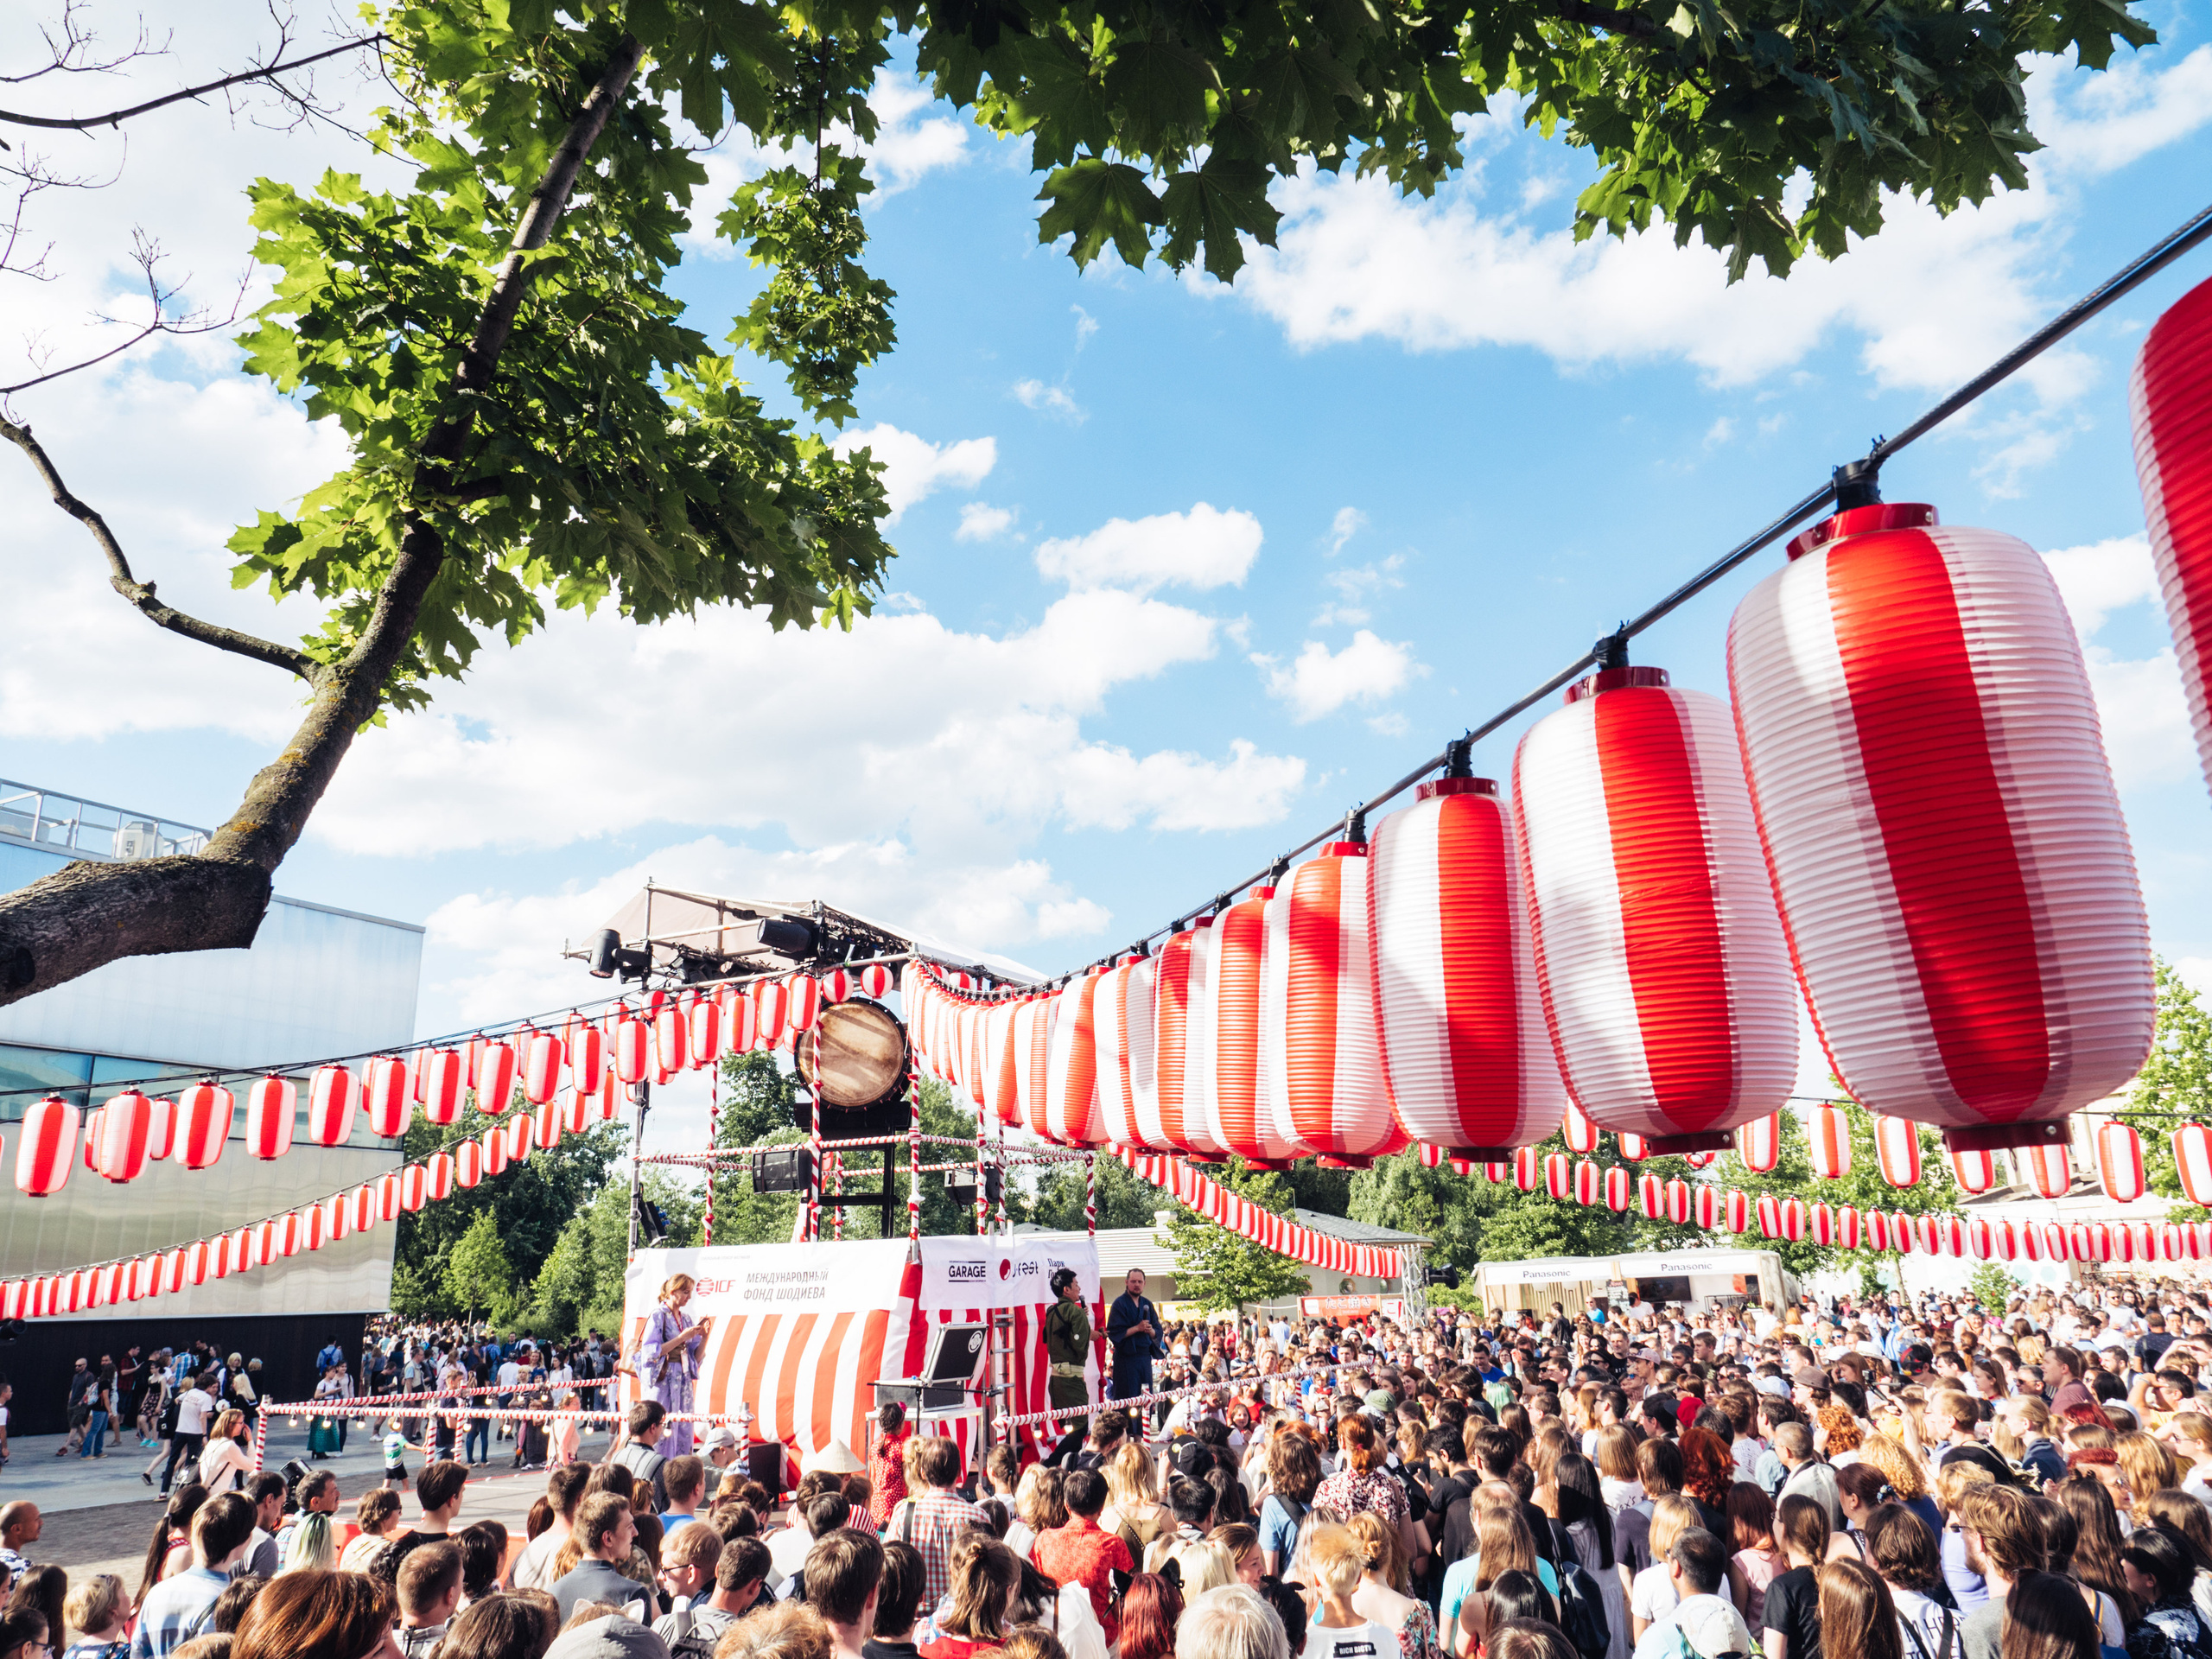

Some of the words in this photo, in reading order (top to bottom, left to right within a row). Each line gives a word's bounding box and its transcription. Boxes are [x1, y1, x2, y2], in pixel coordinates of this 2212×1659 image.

[1047, 1258, 1065, 1270] Парк
[1661, 1262, 1713, 1272] Panasonic
[747, 1268, 829, 1284] МЕЖДУНАРОДНЫЙ
[949, 1265, 986, 1277] GARAGE
[1522, 1269, 1571, 1278] Panasonic
[715, 1280, 736, 1293] ICF
[743, 1288, 775, 1301] ФОНД
[776, 1287, 825, 1301] ШОДИЕВА
